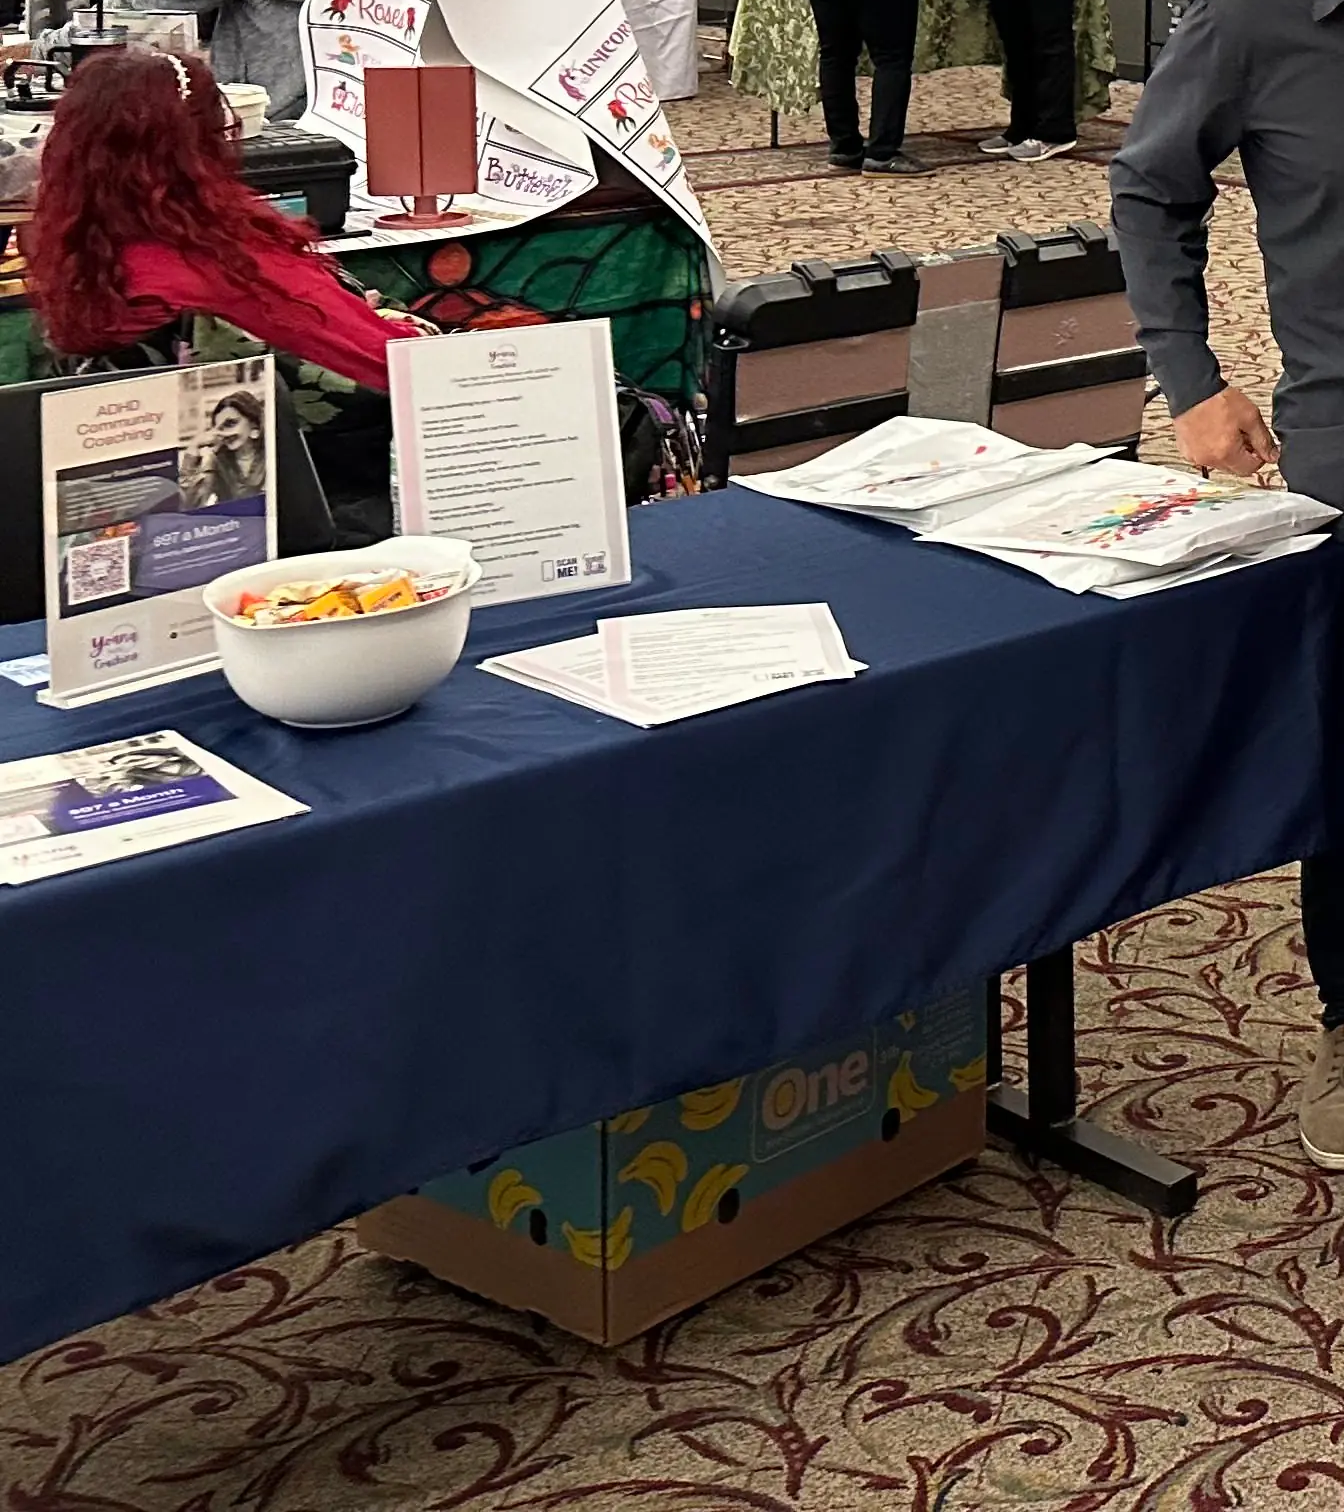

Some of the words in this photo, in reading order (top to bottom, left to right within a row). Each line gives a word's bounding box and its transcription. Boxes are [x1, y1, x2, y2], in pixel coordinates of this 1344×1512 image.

[580, 20, 632, 77] UNICOR
[96, 399, 141, 417] ADHD
[77, 411, 164, 436] Community
[83, 428, 154, 449] Coaching
[557, 566, 578, 578] ME!
[761, 1049, 869, 1132] One
